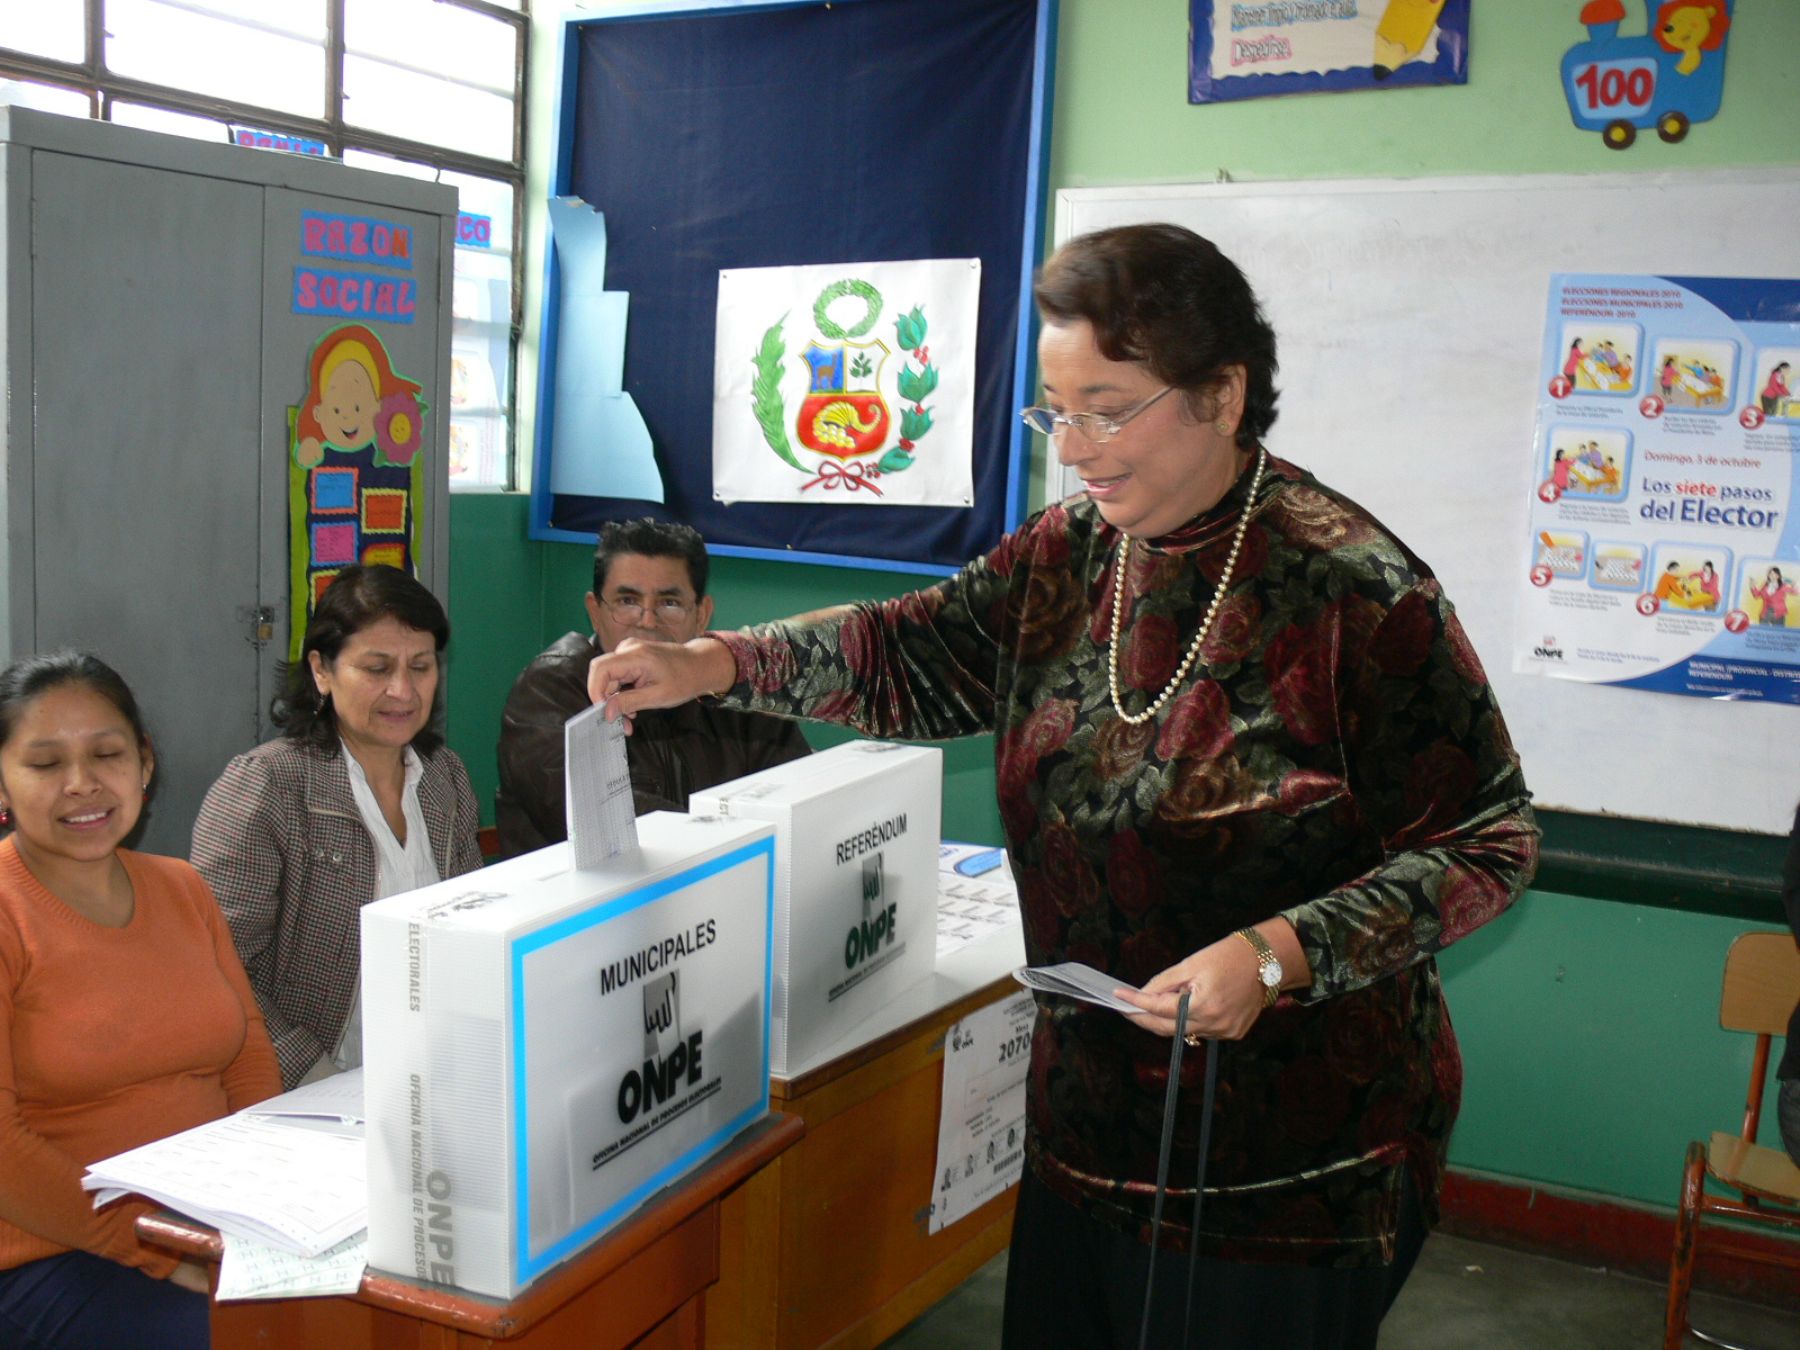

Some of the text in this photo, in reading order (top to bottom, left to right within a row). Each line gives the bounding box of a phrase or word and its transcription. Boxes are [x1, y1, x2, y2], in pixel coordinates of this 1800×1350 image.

[1574, 64, 1655, 110] 100
[304, 218, 409, 259] RAZON
[456, 215, 491, 243] CO
[298, 271, 416, 315] SOCIAL
[1646, 399, 1658, 416] 2
[1744, 411, 1757, 427] 3
[1720, 457, 1762, 469] octubre
[1642, 477, 1772, 501] Los siete pasos
[1640, 498, 1675, 521] del
[1681, 499, 1779, 528] Elector
[1640, 597, 1655, 614] 6
[1730, 614, 1745, 631] 7
[836, 812, 907, 866] REFERÉNDUM
[845, 902, 897, 969] ONPE
[408, 922, 421, 1012] ELECTORALES
[600, 918, 716, 996] MUNICIPALES
[617, 1029, 703, 1125] ONPE
[410, 1073, 421, 1126] OFICINA
[411, 1129, 423, 1194] NACIONAL
[413, 1197, 424, 1215] DE
[426, 1170, 454, 1287] ONPE
